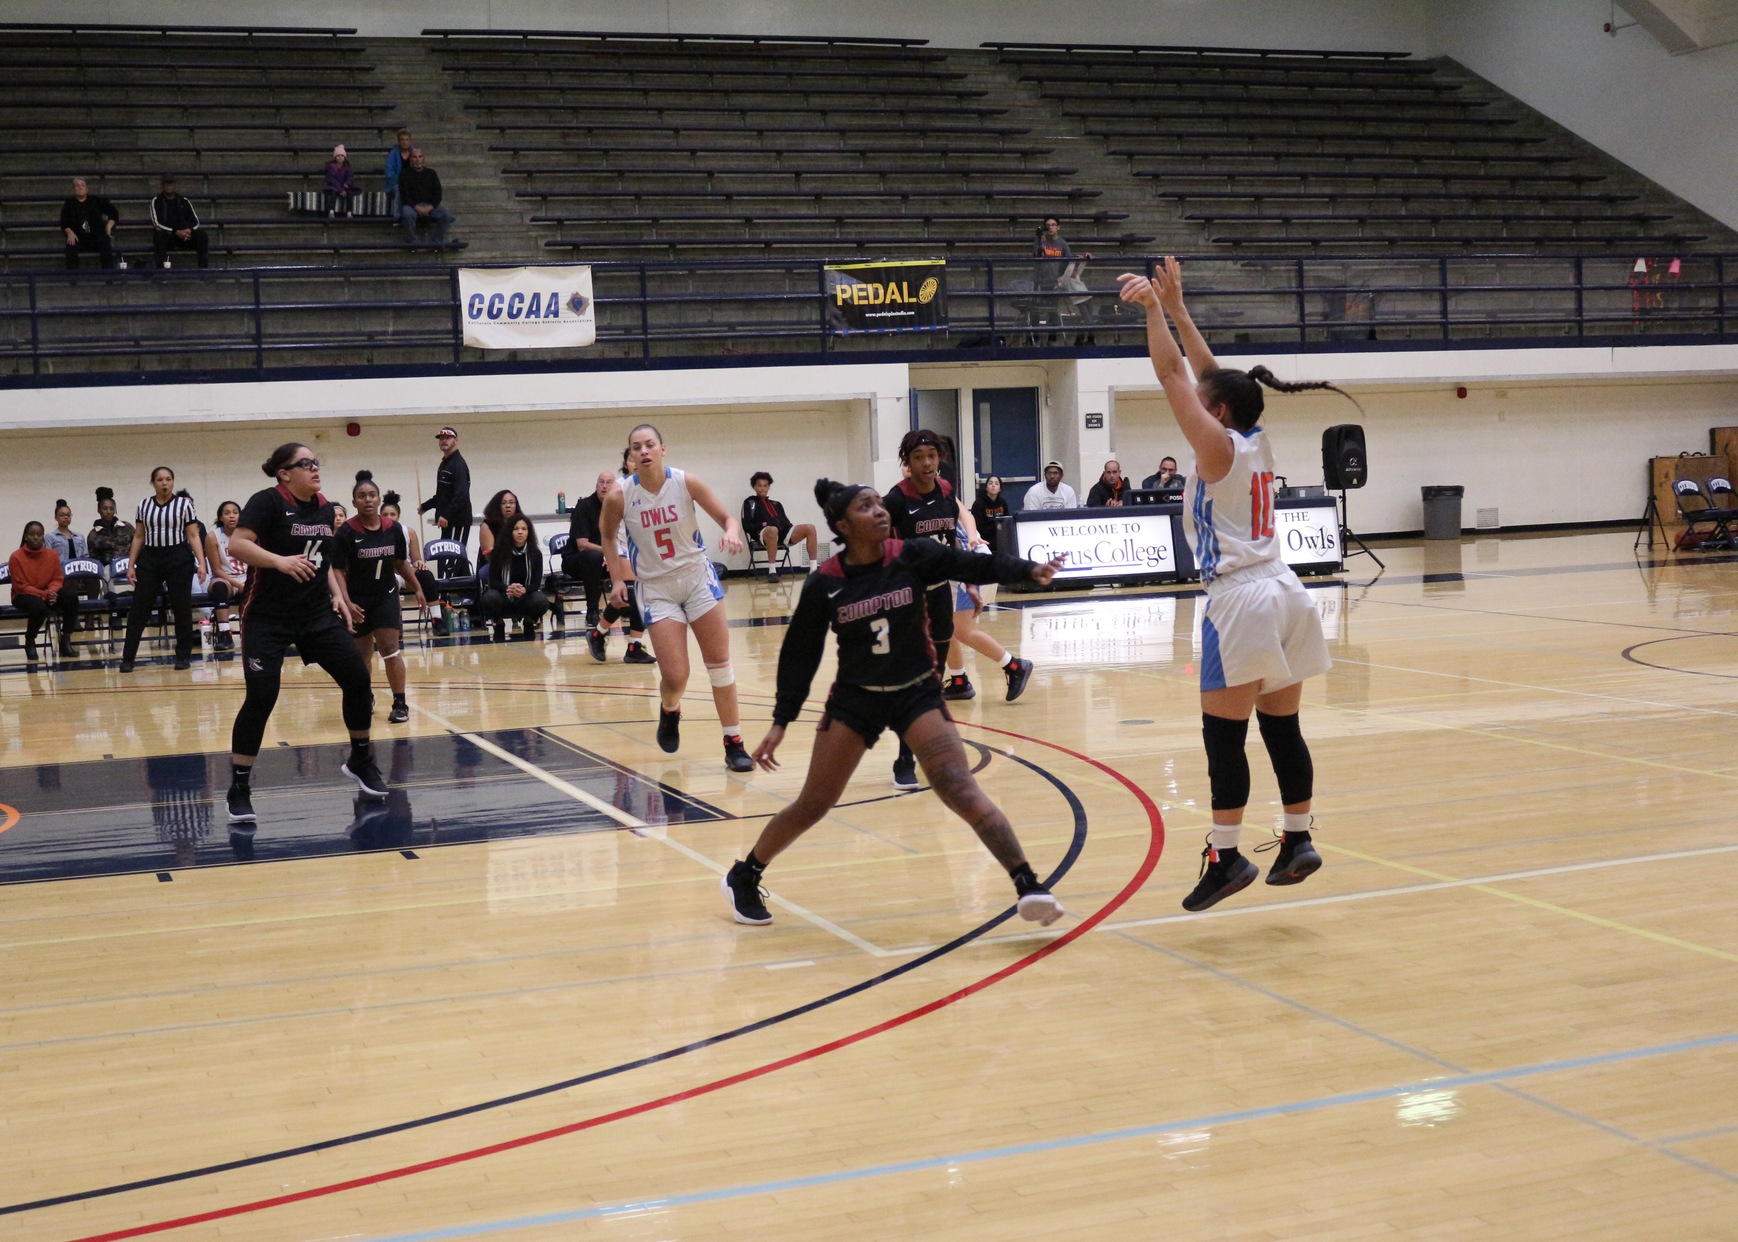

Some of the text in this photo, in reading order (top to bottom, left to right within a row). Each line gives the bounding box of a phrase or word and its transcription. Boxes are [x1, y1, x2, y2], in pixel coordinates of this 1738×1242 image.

[467, 291, 560, 321] CCCAA
[835, 281, 918, 306] PEDAL
[640, 504, 679, 529] OWLS
[1282, 511, 1310, 523] THE
[1048, 522, 1142, 537] WELCOME TO
[1287, 526, 1336, 552] Owls
[303, 540, 323, 568] 14
[430, 541, 461, 555] CITRUS
[654, 527, 676, 561] 5
[1094, 538, 1169, 568] College
[64, 560, 98, 575] CITRUS
[375, 559, 384, 580] 1
[837, 586, 913, 624] COMPTON
[870, 617, 891, 655] 3
